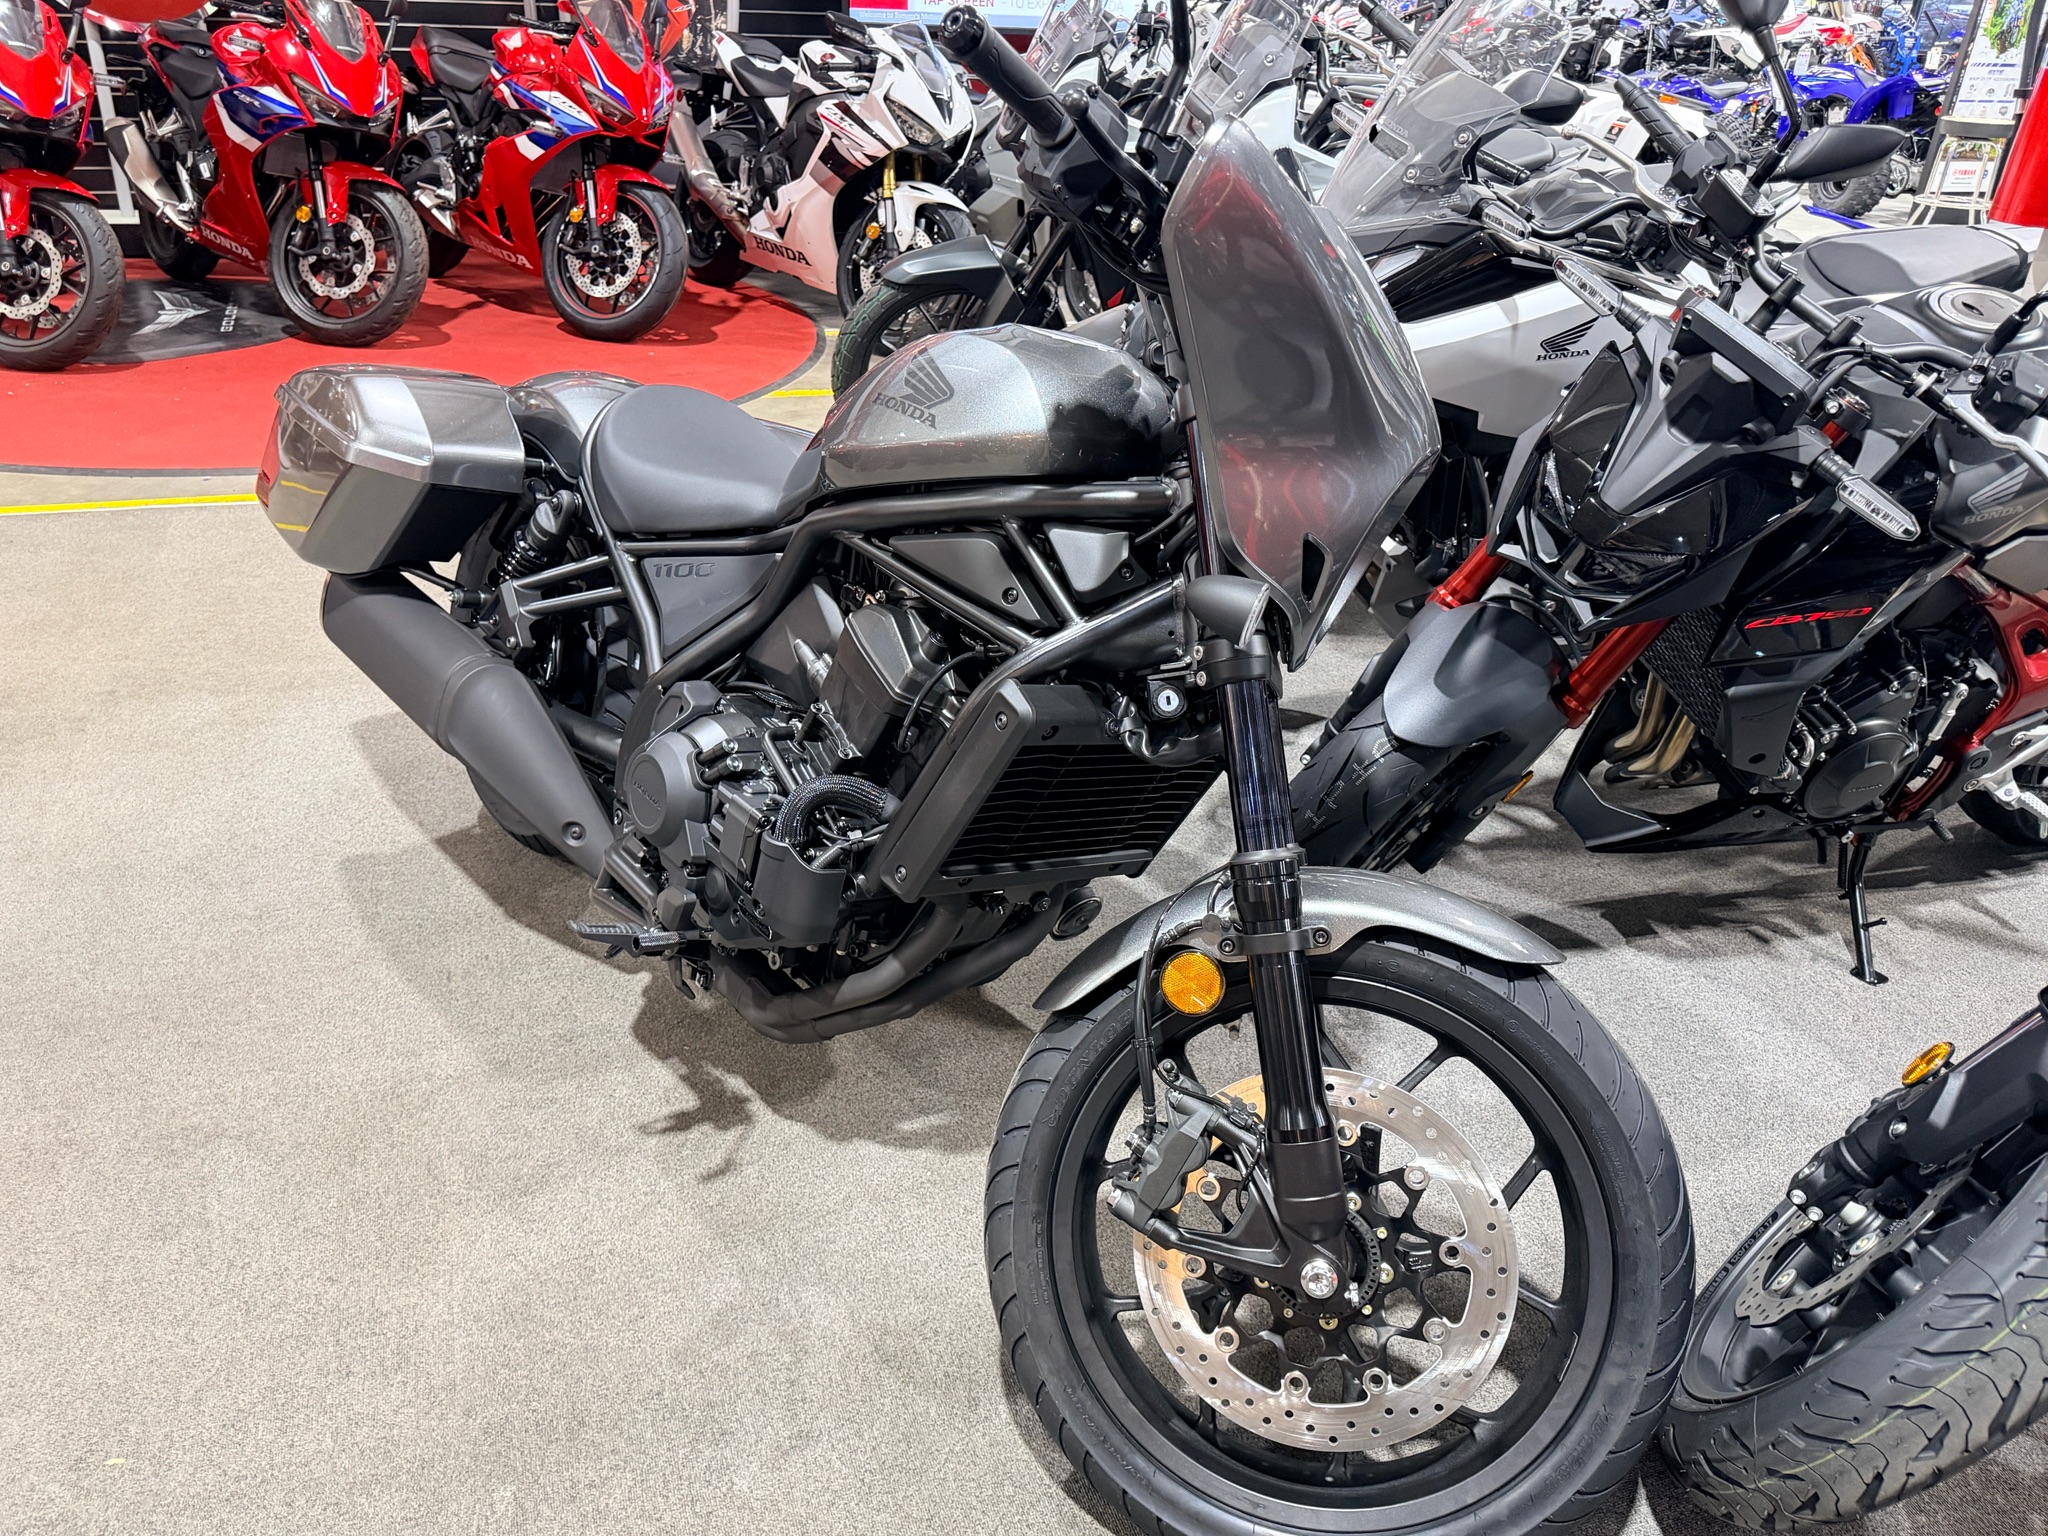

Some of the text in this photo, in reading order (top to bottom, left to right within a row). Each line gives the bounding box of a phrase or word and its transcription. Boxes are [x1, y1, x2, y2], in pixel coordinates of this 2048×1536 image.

[201, 225, 255, 261] HONDA
[470, 235, 534, 269] HONDA
[753, 235, 813, 267] HONDA
[1535, 349, 1592, 362] HONDA
[872, 392, 937, 430] HONDA
[1963, 505, 2024, 525] HONDA
[1744, 607, 1873, 629] CB750
[1729, 1238, 1755, 1264] 120/70
[1753, 1226, 1767, 1240] ZR
[1765, 1216, 1775, 1229] 17
